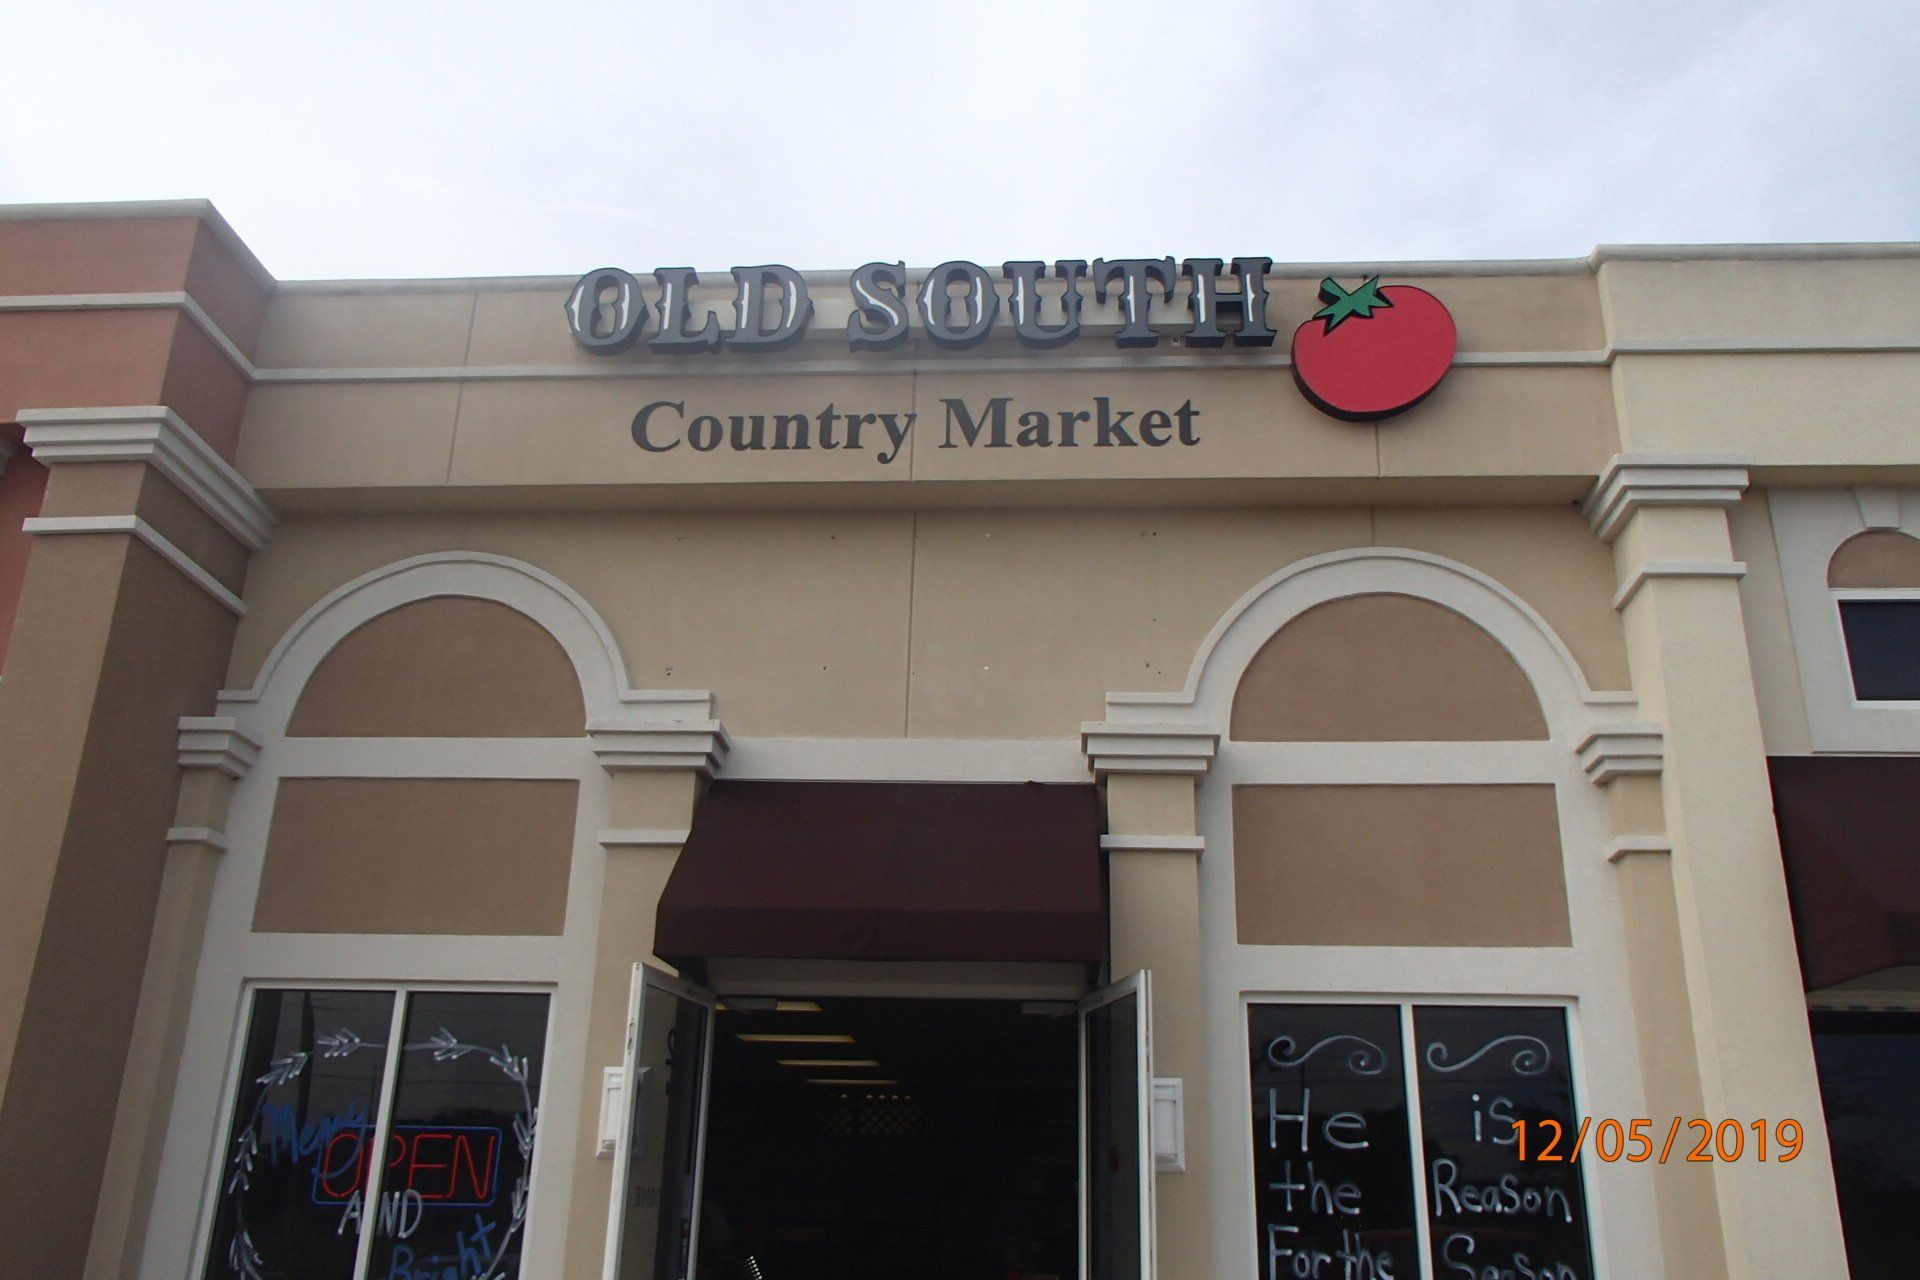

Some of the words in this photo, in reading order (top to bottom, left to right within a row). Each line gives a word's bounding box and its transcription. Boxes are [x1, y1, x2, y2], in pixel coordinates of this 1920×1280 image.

[564, 264, 815, 354] OLD
[847, 256, 1277, 351] SOUTH
[631, 401, 917, 464] Country
[938, 397, 1200, 448] Market
[1269, 1087, 1369, 1152] He
[322, 1132, 496, 1201] OPEN
[1269, 1160, 1362, 1215] the
[337, 1188, 423, 1239] AND
[1268, 1223, 1332, 1280] For
[1335, 1228, 1394, 1280] the
